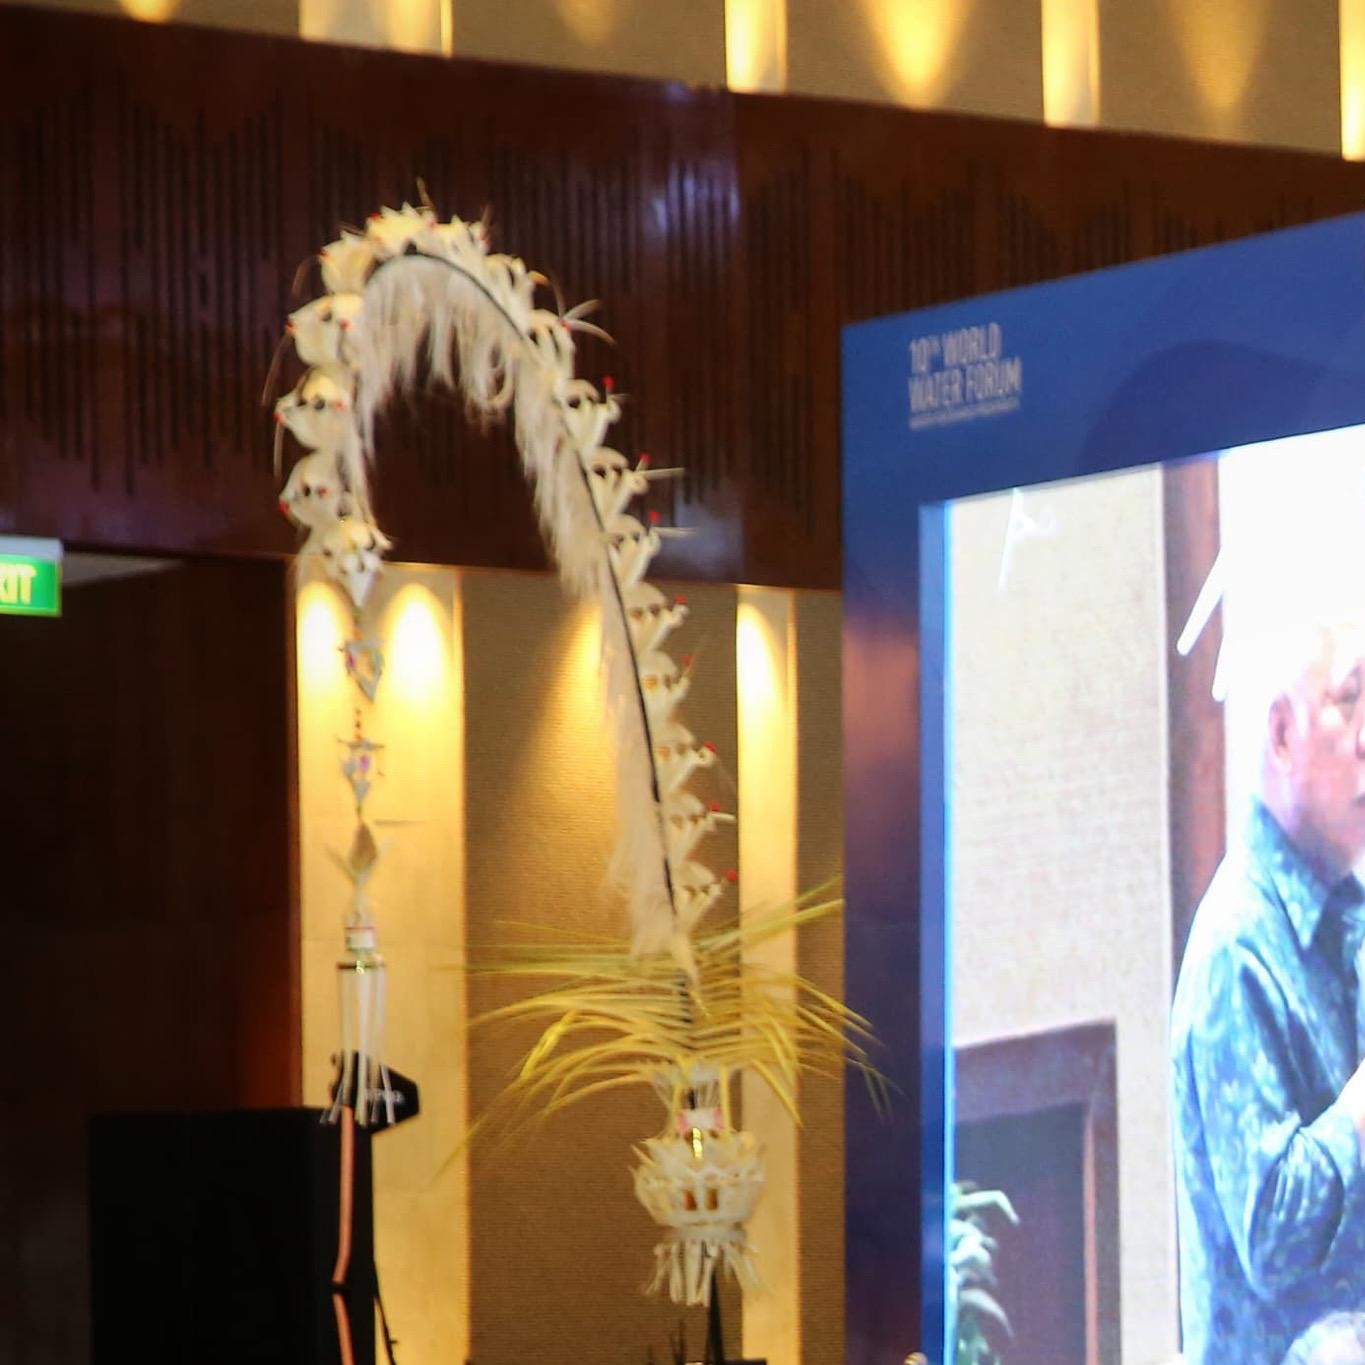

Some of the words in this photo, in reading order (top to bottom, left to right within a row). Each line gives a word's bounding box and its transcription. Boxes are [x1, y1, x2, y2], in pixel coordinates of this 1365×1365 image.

[942, 322, 1002, 367] WORLD
[908, 367, 962, 413] WATER
[965, 356, 1022, 404] FORUM
